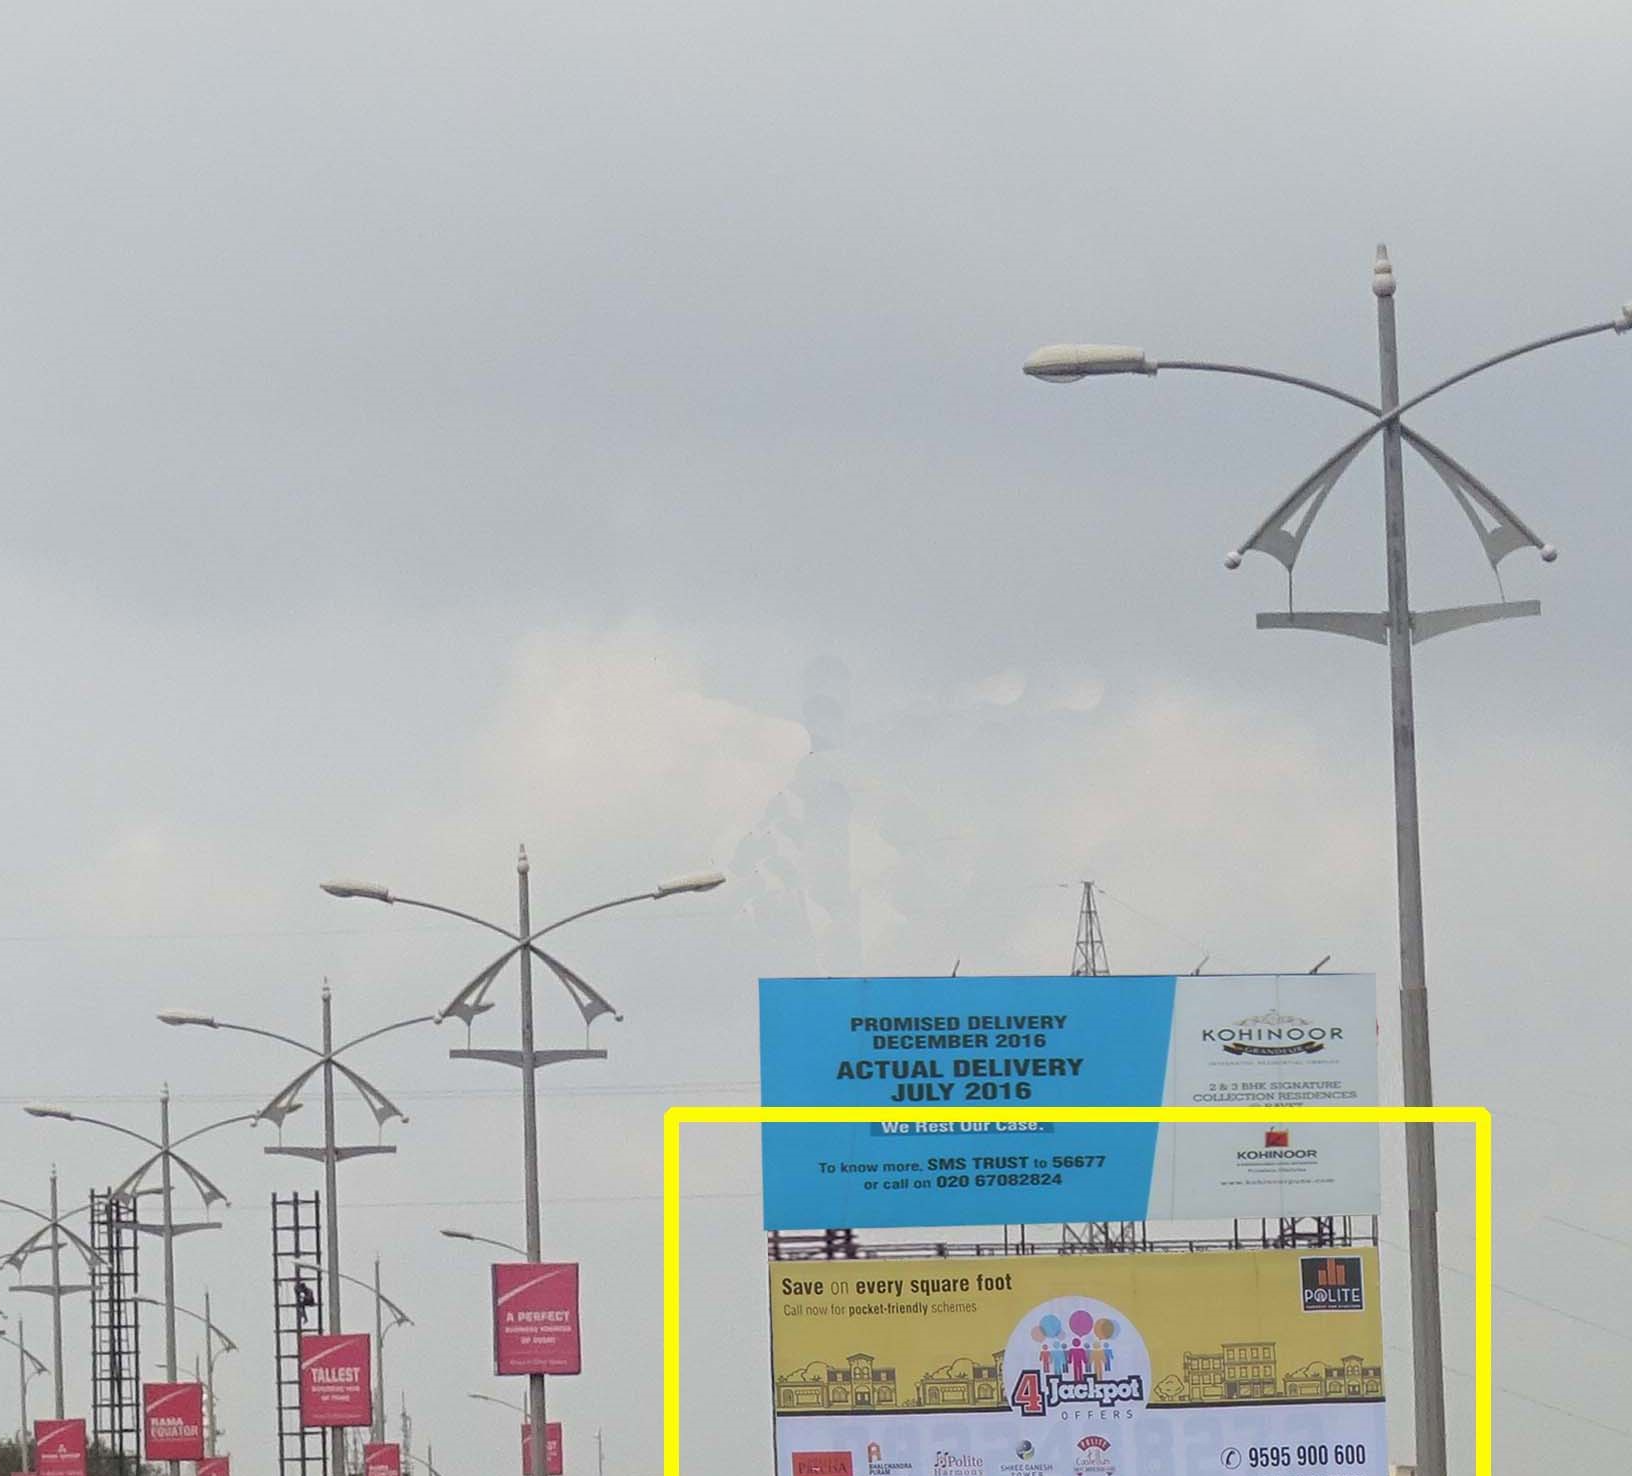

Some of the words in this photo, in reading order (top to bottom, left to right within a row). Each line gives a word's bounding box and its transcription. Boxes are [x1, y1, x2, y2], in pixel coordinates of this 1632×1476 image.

[851, 1016, 960, 1032] PROMISED
[967, 1014, 1068, 1031] DELIVERY
[872, 1034, 989, 1050] DECEMBER
[995, 1033, 1047, 1049] 2016
[1202, 1027, 1344, 1042] KOHINOOR
[836, 1060, 945, 1080] ACTUAL
[953, 1058, 1084, 1078] DELIVERY
[891, 1083, 955, 1103] JULY
[965, 1081, 1033, 1101] 2016
[1270, 1080, 1342, 1090] SIGNATURE
[1193, 1092, 1274, 1102] COLLECTION
[1278, 1090, 1358, 1101] RESIDENCES
[881, 1122, 909, 1134] We
[915, 1122, 955, 1133] Rest
[960, 1122, 991, 1132] Our
[995, 1121, 1045, 1132] Case.
[1236, 1149, 1318, 1160] KOHINOOR
[819, 1161, 835, 1174] To
[840, 1161, 879, 1174] know
[927, 1158, 967, 1172] SMS
[972, 1156, 1029, 1170] TRUST
[1034, 1158, 1048, 1170] to
[1052, 1155, 1107, 1169] 56677
[864, 1179, 879, 1191] or
[882, 1178, 909, 1191] call
[913, 1179, 932, 1190] on
[936, 1175, 970, 1189] 020
[974, 1173, 1063, 1188] 67082824
[781, 1278, 824, 1295] Save
[830, 1280, 849, 1295] on
[855, 1278, 904, 1297] every
[910, 1276, 970, 1296] square
[976, 1273, 1013, 1292] foot
[1304, 1288, 1361, 1302] POLITE
[506, 1312, 515, 1322] A
[517, 1311, 571, 1322] PERFECT
[783, 1304, 803, 1317] Call
[805, 1306, 828, 1317] now
[830, 1303, 847, 1316] for
[848, 1302, 929, 1318] pocket-friendly
[931, 1301, 978, 1314] schemes
[311, 1367, 361, 1383] TALLEST
[1012, 1368, 1046, 1417] 4
[1047, 1374, 1144, 1405] Jackpot
[151, 1416, 184, 1427] RAMA
[1061, 1409, 1134, 1420] OFFERS
[151, 1425, 199, 1437] EQUATOR
[948, 1454, 984, 1468] Polite
[1248, 1447, 1291, 1468] 9595
[1297, 1445, 1329, 1467] 900
[1334, 1444, 1366, 1466] 600
